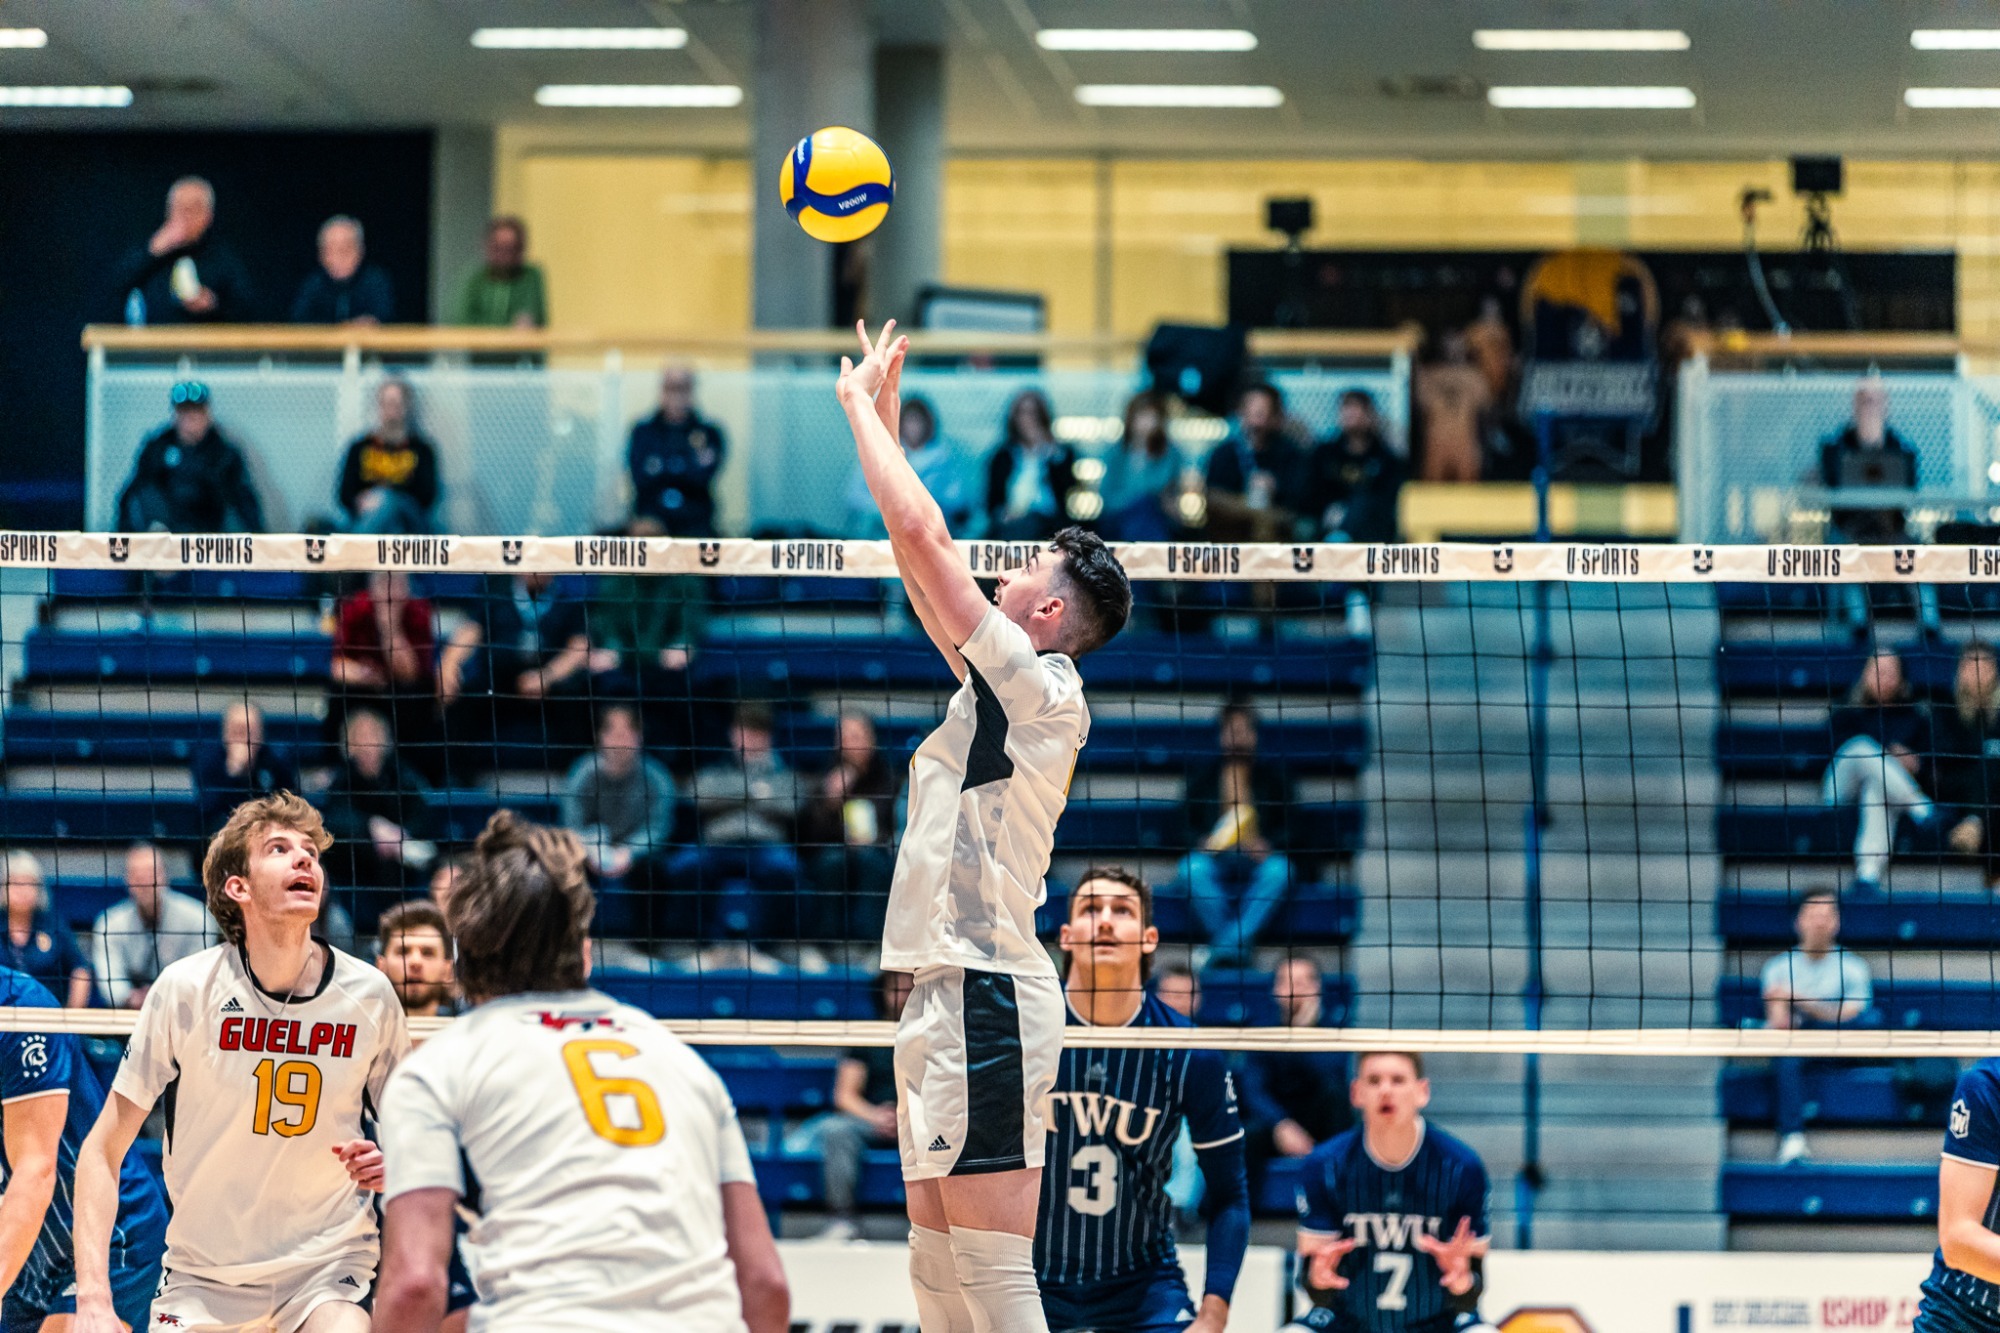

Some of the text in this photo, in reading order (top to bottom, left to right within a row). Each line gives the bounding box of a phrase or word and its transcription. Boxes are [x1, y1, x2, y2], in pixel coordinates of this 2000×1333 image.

[219, 1017, 357, 1058] GUELPH
[252, 1058, 323, 1138] 19
[561, 1039, 667, 1148] 6
[1046, 1091, 1161, 1146] TWU
[1067, 1144, 1118, 1217] 3
[1343, 1212, 1443, 1252] TWU
[1373, 1252, 1413, 1310] 7
